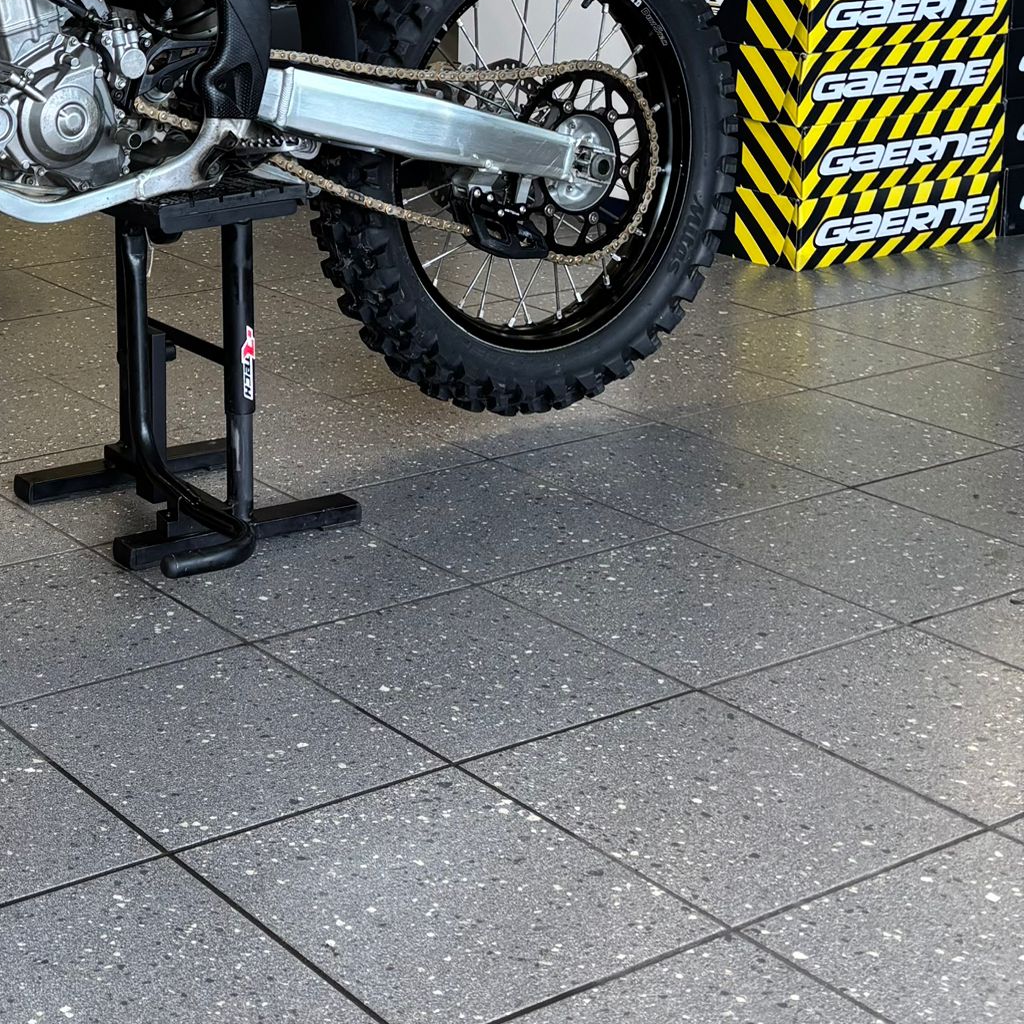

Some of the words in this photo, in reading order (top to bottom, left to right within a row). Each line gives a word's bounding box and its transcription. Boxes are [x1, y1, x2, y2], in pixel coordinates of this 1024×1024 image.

[812, 58, 992, 102] GAERNE
[818, 128, 994, 176] GAERNE
[814, 195, 991, 248] GAERNE
